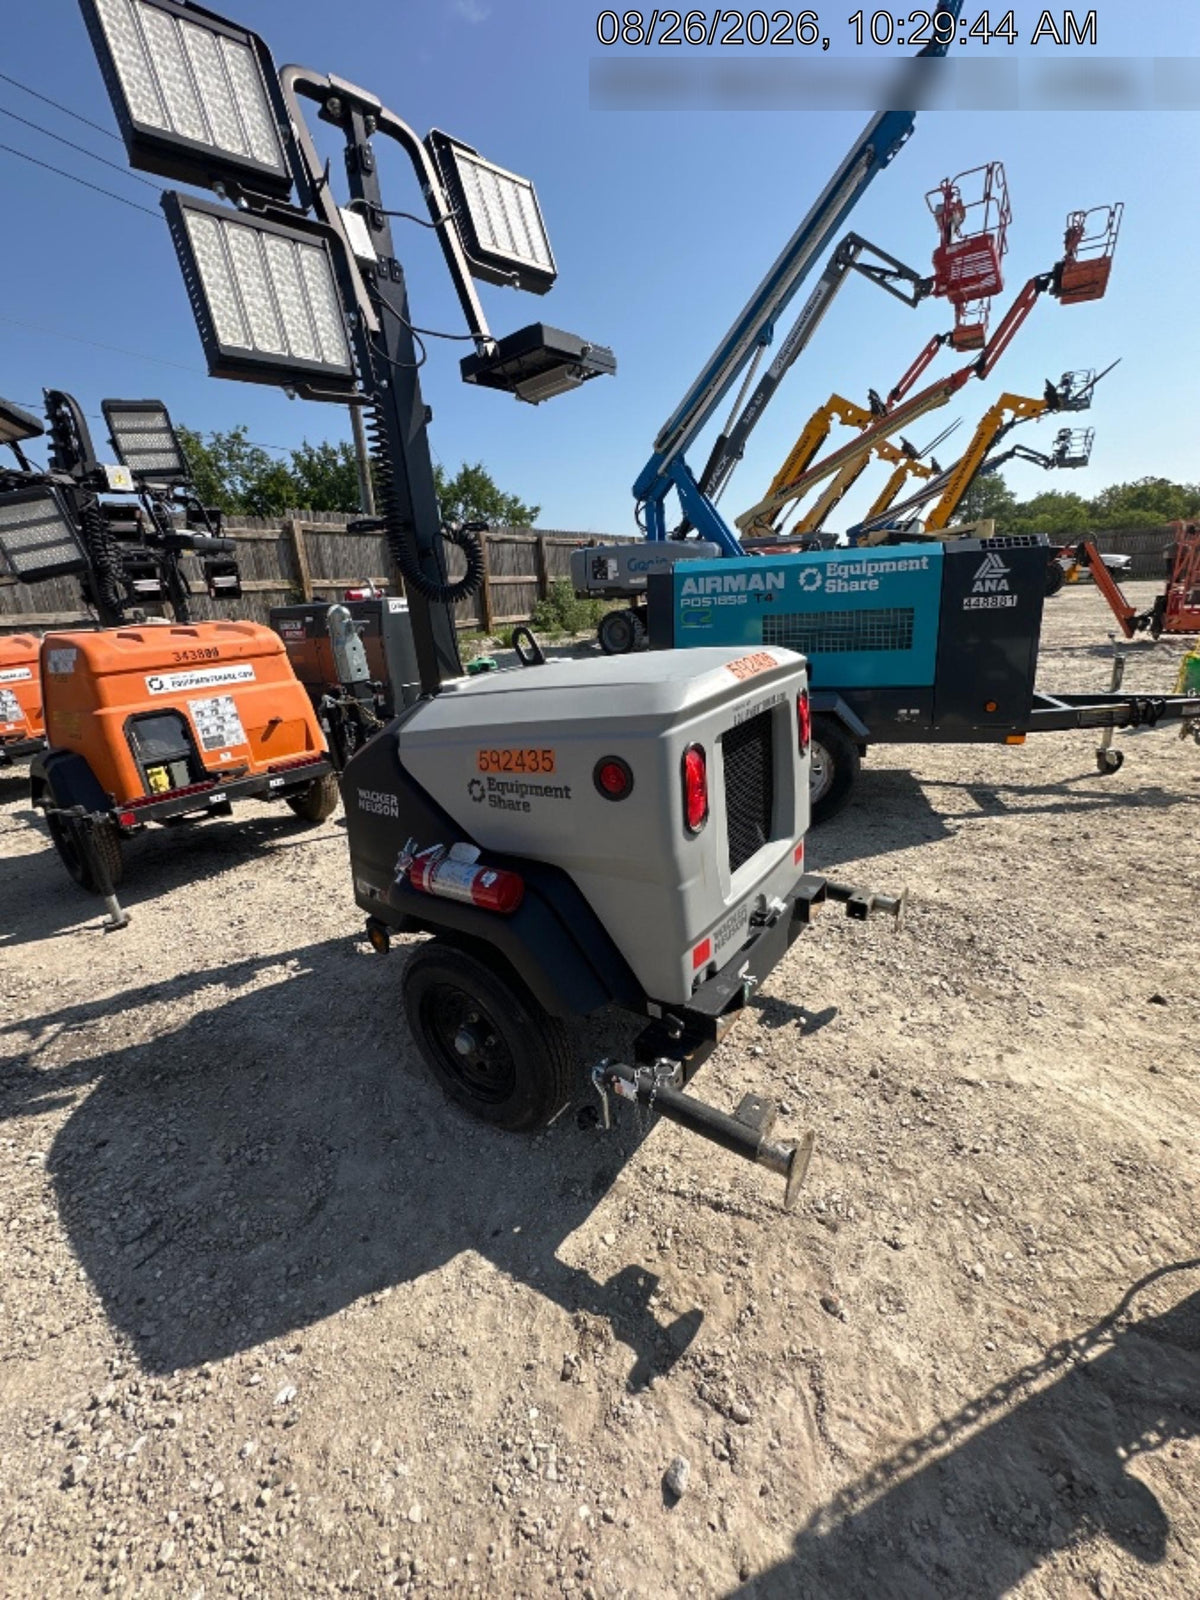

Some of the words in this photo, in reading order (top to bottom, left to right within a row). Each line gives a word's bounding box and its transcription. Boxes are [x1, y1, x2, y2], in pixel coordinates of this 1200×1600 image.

[825, 555, 929, 578] Equipment
[681, 571, 785, 595] AIRMAN
[825, 577, 879, 593] Share
[972, 579, 1009, 593] ANA
[479, 749, 554, 772] 592435
[357, 788, 398, 806] WACKER
[487, 777, 572, 799] Equipment
[359, 798, 399, 818] NEUSON
[488, 794, 531, 812] Share
